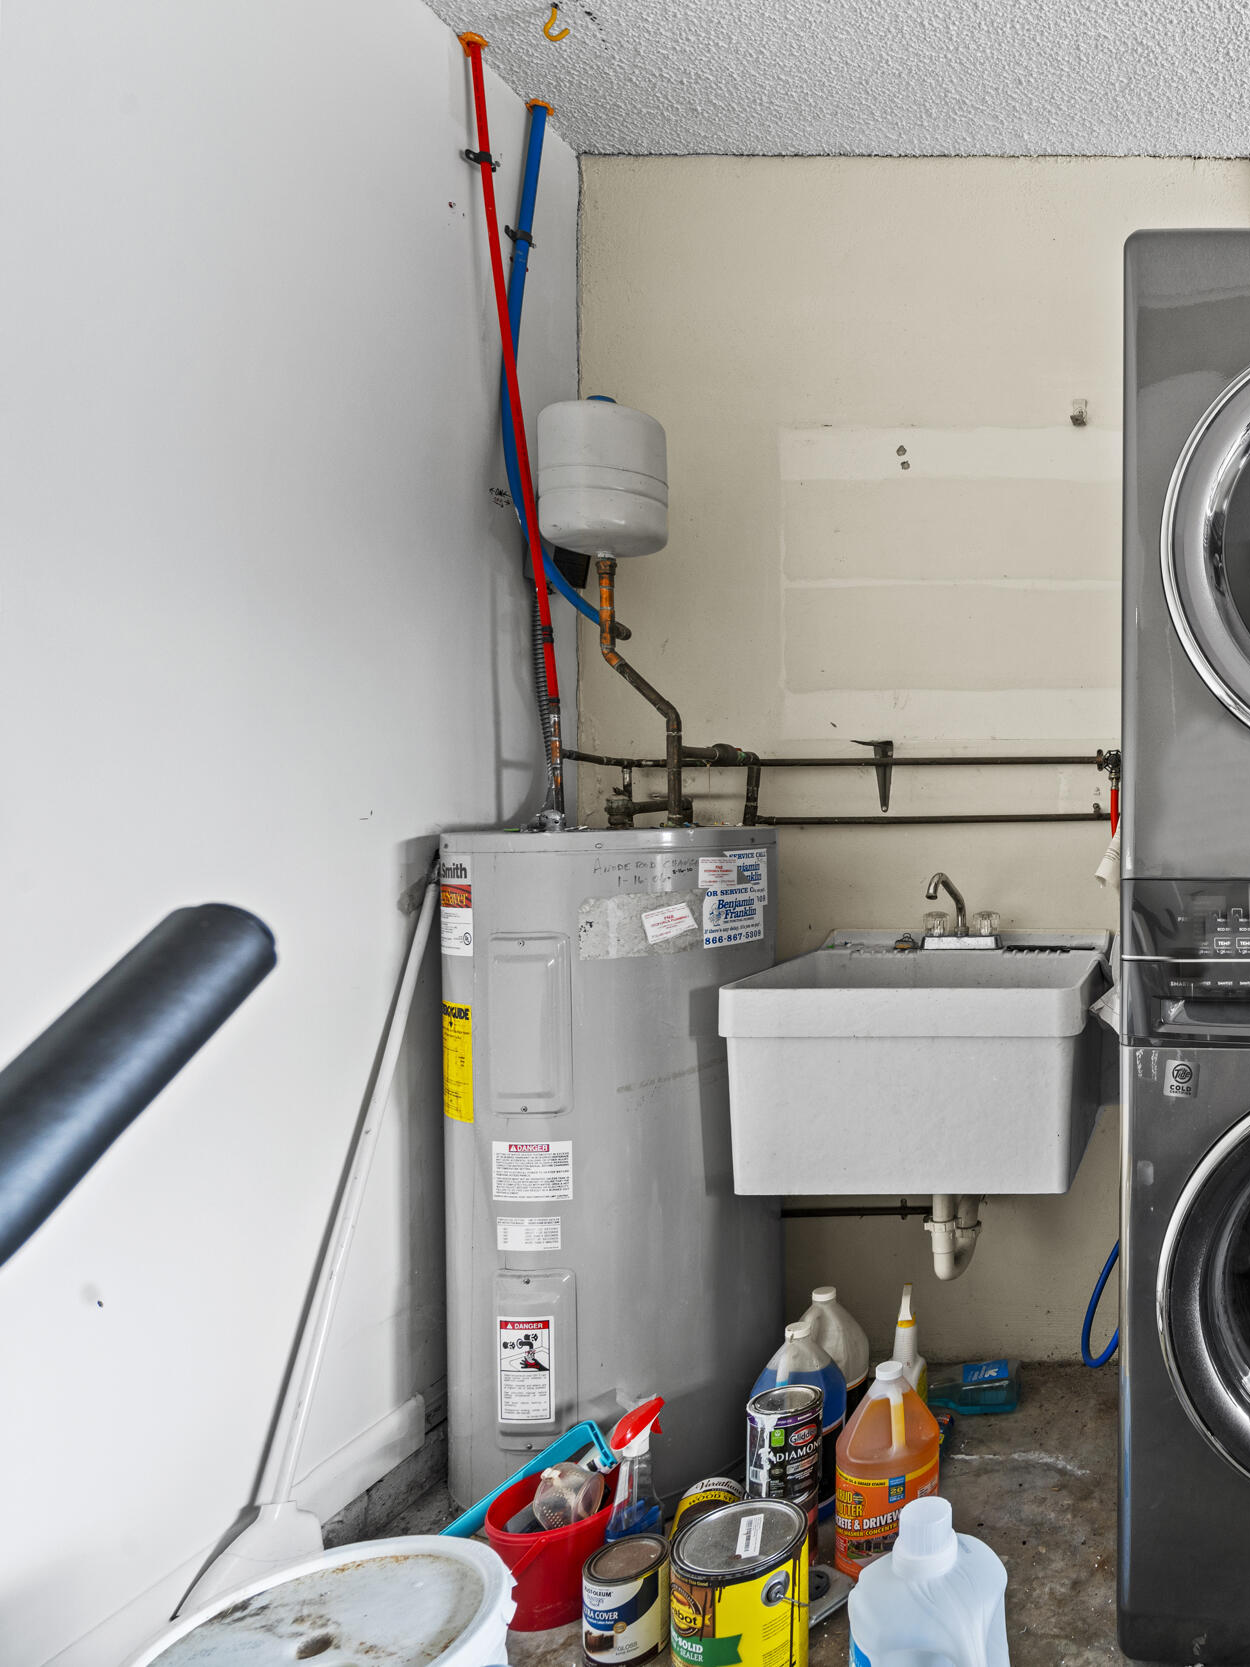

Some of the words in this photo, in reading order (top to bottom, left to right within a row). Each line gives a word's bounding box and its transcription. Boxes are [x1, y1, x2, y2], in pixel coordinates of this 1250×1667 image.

[720, 886, 748, 896] SERVICE
[717, 896, 755, 911] Benjamin
[724, 906, 757, 919] Franklin
[705, 930, 762, 945] 866-867-5309
[1174, 1068, 1191, 1080] Tide
[1169, 1084, 1192, 1092] COLD
[517, 1144, 548, 1152] DANGER
[776, 1439, 822, 1462] DIAMON
[853, 1519, 861, 1530] &
[595, 1611, 619, 1620] COVER
[680, 1647, 704, 1662] SEALER
